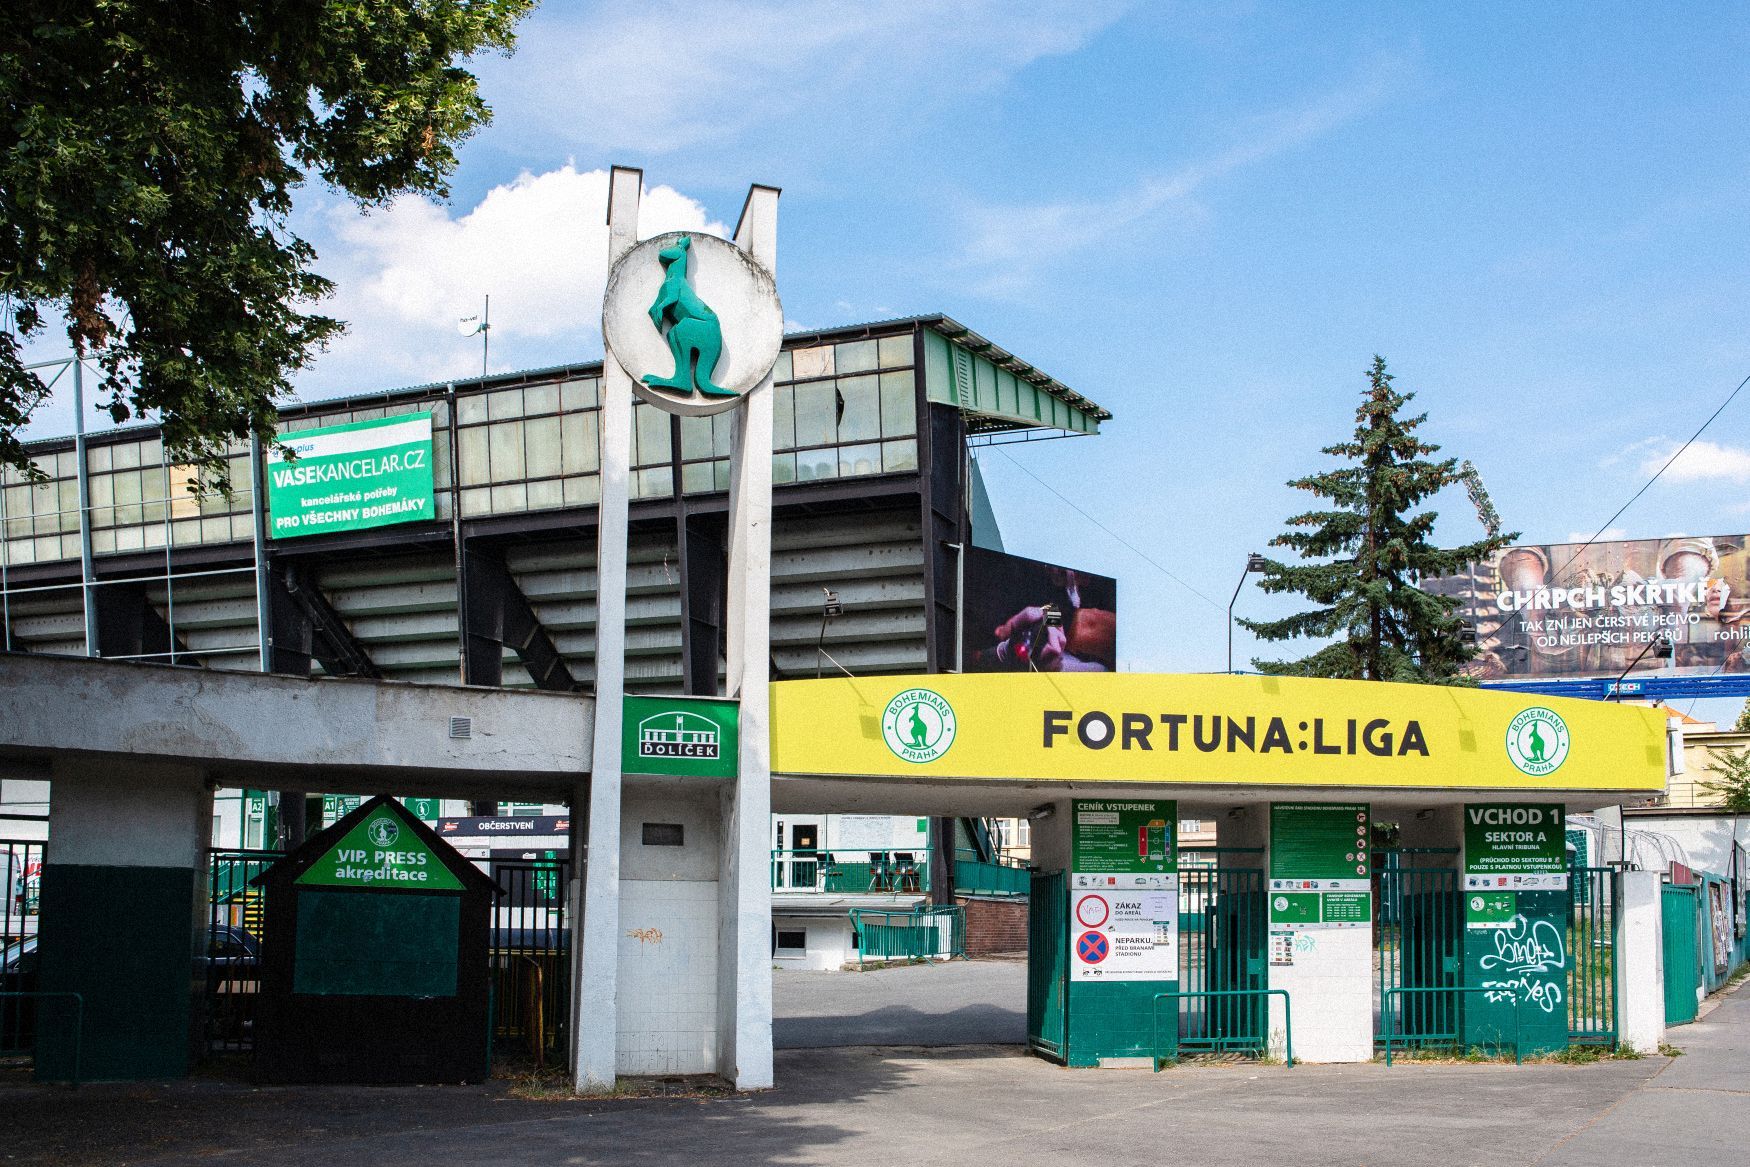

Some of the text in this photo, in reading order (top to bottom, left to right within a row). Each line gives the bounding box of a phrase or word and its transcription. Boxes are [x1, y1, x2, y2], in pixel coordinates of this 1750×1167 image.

[273, 450, 425, 488] VASEKANCELAR.CZ
[301, 486, 398, 507] kancelářské potřeby
[276, 498, 426, 529] PRO VŠECHNY BOHEMÁKY
[1497, 584, 1605, 612] CHŘPCH
[1520, 611, 1700, 632] TAK ZNÍ JEN ČERSTVÉ PEČIVO
[1537, 636, 1557, 647] OD
[1561, 630, 1630, 646] NEJLEPŠÍCH
[1714, 626, 1750, 641] rohli
[889, 692, 950, 717] BOHEMIANS
[1512, 710, 1565, 733] BOHEMIANS
[1043, 710, 1430, 757] FORTUNA:LIGA
[644, 742, 715, 756] ĎOLÍČEK
[902, 748, 938, 760] PRAHA
[1523, 762, 1554, 773] PRAHA
[252, 803, 262, 811] A2
[324, 801, 335, 810] A1
[1077, 801, 1155, 811] CENÍK VSTUPENEK
[1469, 808, 1559, 825] VCHOD 1
[478, 820, 535, 830] OBČERSTVENÍ
[1485, 831, 1547, 842] SEKTOR A
[337, 849, 427, 865] VIP, PRESS
[335, 865, 428, 881] akreditace
[1115, 900, 1142, 909] ZÁKAZ
